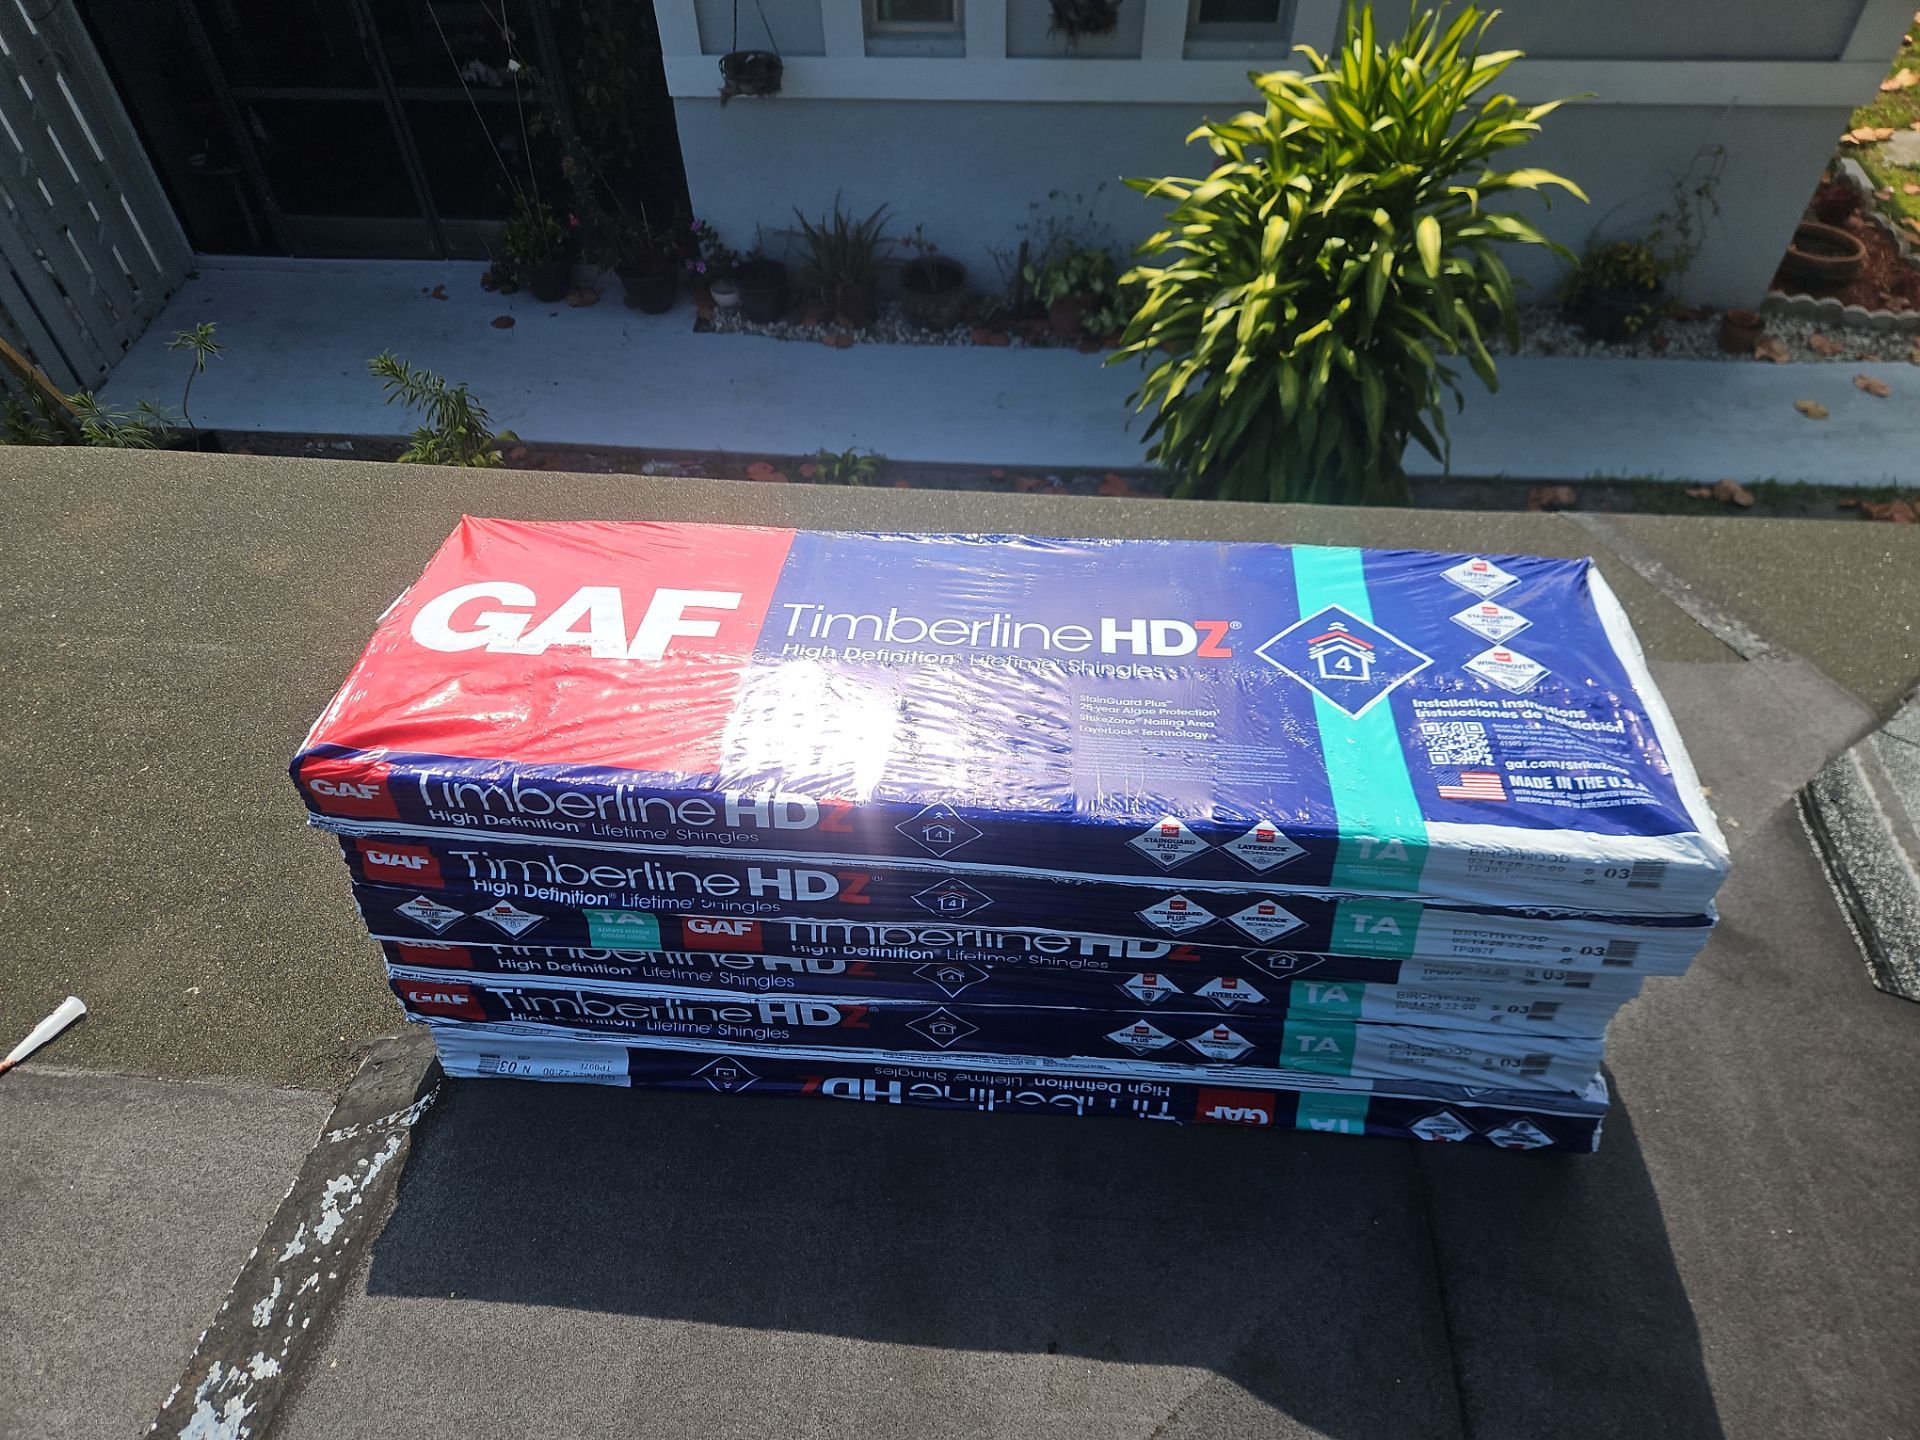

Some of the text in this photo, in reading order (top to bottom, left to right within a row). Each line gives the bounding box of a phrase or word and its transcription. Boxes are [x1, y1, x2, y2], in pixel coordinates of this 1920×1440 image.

[410, 581, 742, 660] GAF
[783, 603, 1094, 652] Timberline
[782, 643, 836, 661] High
[1068, 659, 1164, 679] Shingles
[1334, 656, 1354, 672] 4
[1079, 695, 1142, 707] StainGuard
[1412, 699, 1498, 709] Installation
[1122, 707, 1156, 717] Algae
[1415, 708, 1518, 719] Instrucciones
[1522, 710, 1542, 720] de
[1079, 714, 1215, 728] StrikeZone Nailing Area
[1141, 728, 1209, 740] Technology
[310, 779, 380, 800] GAF
[1508, 775, 1553, 790] MADE
[1556, 775, 1573, 791] IN
[1575, 775, 1606, 791] THE
[410, 768, 716, 826] Timberline
[429, 809, 478, 826] High
[676, 829, 760, 844] Shingles
[1144, 837, 1197, 845] STAINGUARD
[1354, 837, 1409, 861] TA
[366, 850, 429, 870] GAF
[448, 850, 742, 897] Timberline
[1604, 867, 1631, 879] 03
[472, 878, 518, 898] High
[594, 911, 646, 925] TA
[1350, 913, 1402, 936] TA
[687, 919, 754, 936] GAF
[1580, 946, 1605, 956] 03
[1028, 955, 1109, 970] Shingles
[499, 958, 542, 972] High
[719, 971, 795, 990] Shingles
[408, 992, 469, 1004] GAF
[1304, 983, 1349, 1004] TA
[486, 988, 752, 1023] Timberline
[1507, 1004, 1530, 1014] 03
[717, 1024, 790, 1041] Shingles
[1296, 1036, 1343, 1053] TA
[499, 1060, 518, 1074] 03
[1500, 1059, 1521, 1067] 03
[874, 1066, 947, 1082] Shingles
[1128, 1082, 1171, 1097] High
